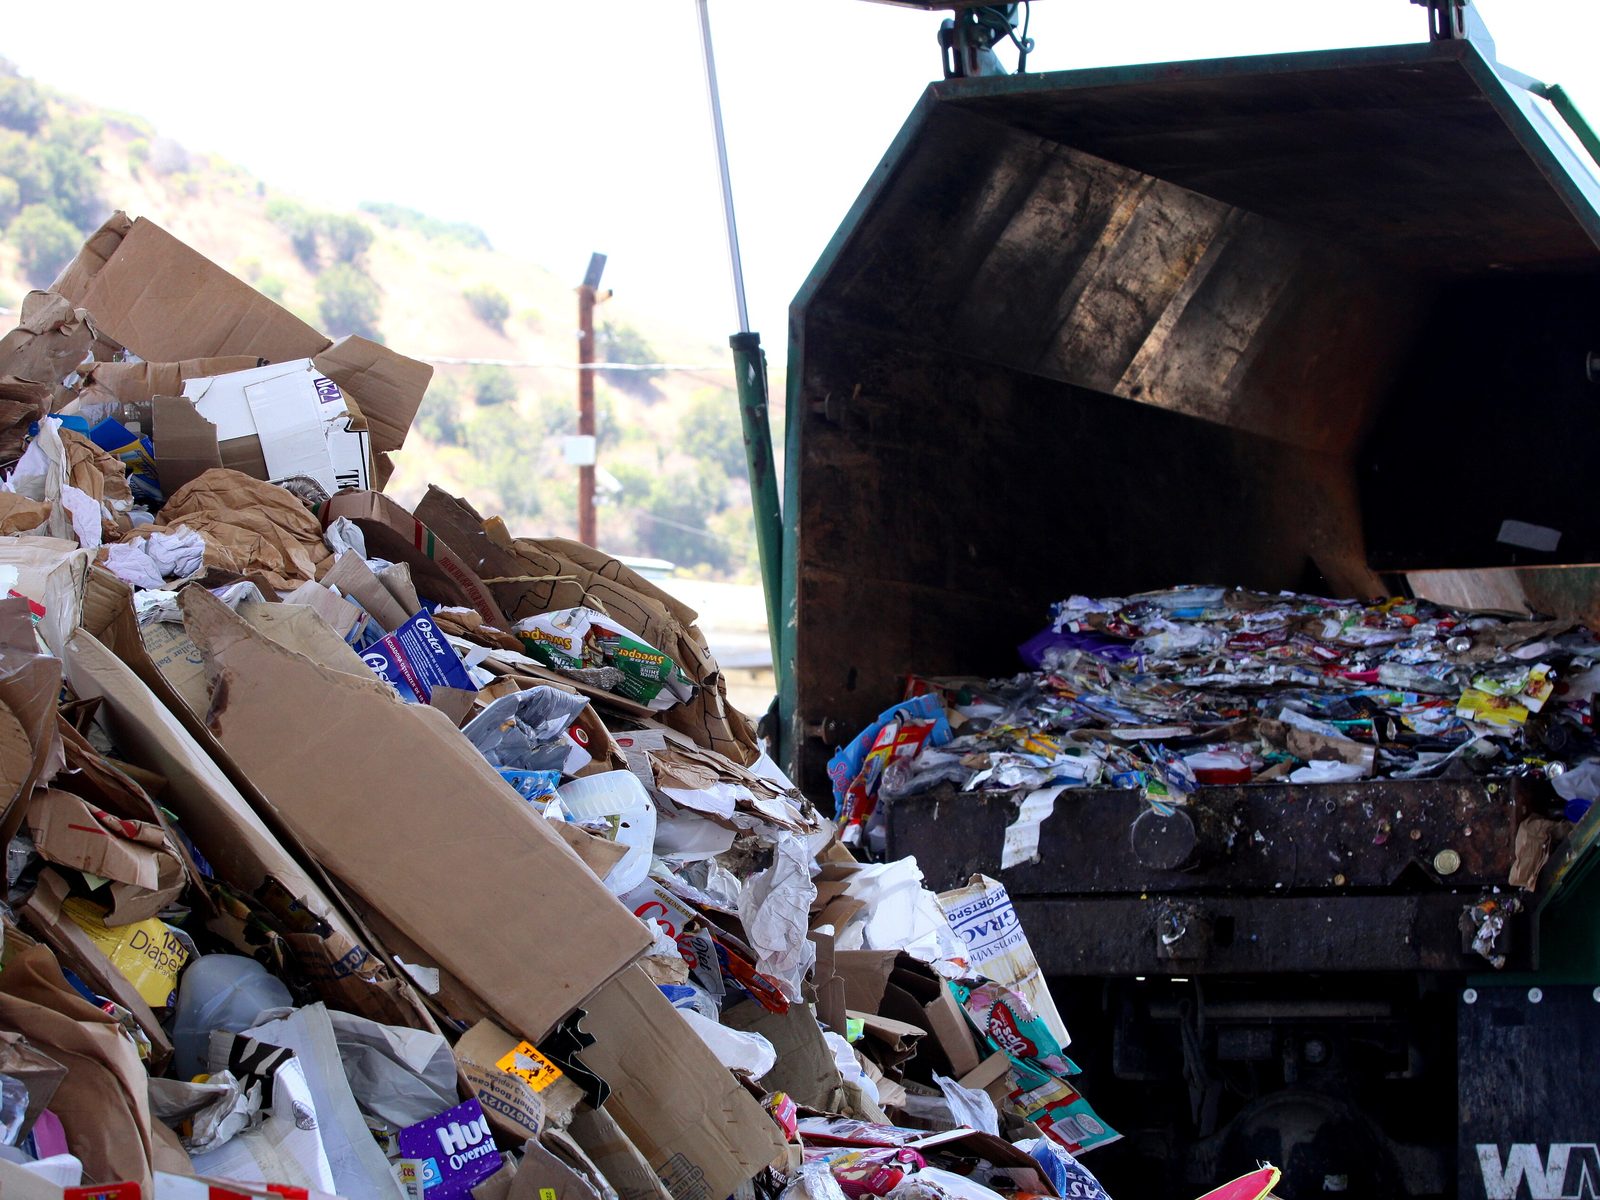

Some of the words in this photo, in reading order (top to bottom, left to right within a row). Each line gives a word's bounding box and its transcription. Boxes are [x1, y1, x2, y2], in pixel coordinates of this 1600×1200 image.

[416, 618, 446, 656] Oster
[520, 627, 573, 651] Sweeper
[385, 636, 404, 662] LICUADORA
[400, 660, 417, 689] OSTERIZER
[617, 648, 664, 665] Sweeper
[654, 888, 684, 913] CAFFEINE
[960, 907, 1019, 945] GRAC
[162, 931, 185, 962] 144
[691, 937, 712, 972] Diet
[523, 1047, 556, 1074] TEAM
[479, 1092, 537, 1130] 9467012Y
[514, 1097, 535, 1117] Shelf
[421, 1161, 435, 1180] 6
